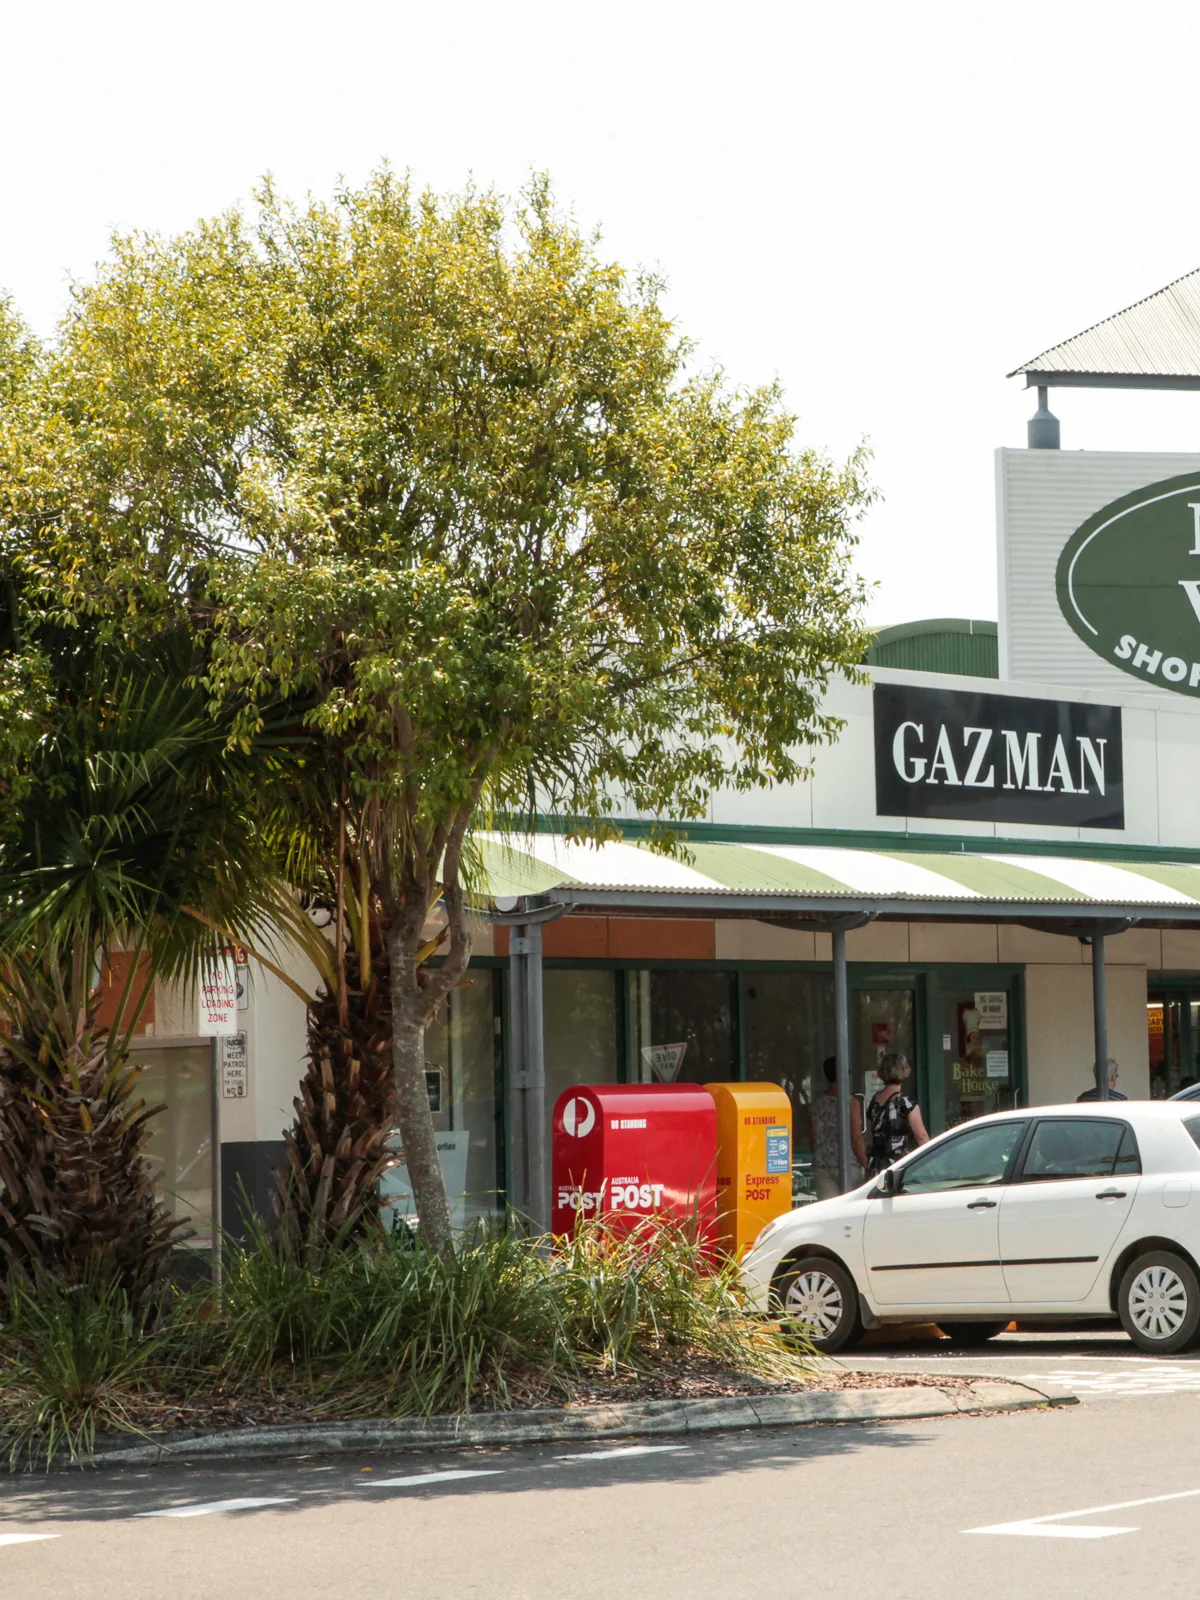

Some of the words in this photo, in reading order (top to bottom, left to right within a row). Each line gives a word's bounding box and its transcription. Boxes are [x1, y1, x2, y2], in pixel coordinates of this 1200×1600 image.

[892, 721, 1108, 796] GAZMAN
[202, 985, 234, 995] PARKING
[202, 999, 234, 1009] LOADING
[207, 1013, 228, 1022] ZONE
[226, 1070, 242, 1078] HERE
[952, 1062, 984, 1080] Bake
[961, 1078, 998, 1097] House
[611, 1120, 618, 1130] NO
[620, 1119, 647, 1130] STANDING
[752, 1116, 776, 1125] STANDING
[437, 1143, 456, 1152] erties
[611, 1176, 639, 1185] AUSTRALIA
[745, 1174, 780, 1187] Express
[611, 1184, 664, 1209] POST
[745, 1189, 771, 1201] POST
[558, 1192, 603, 1210] POST
